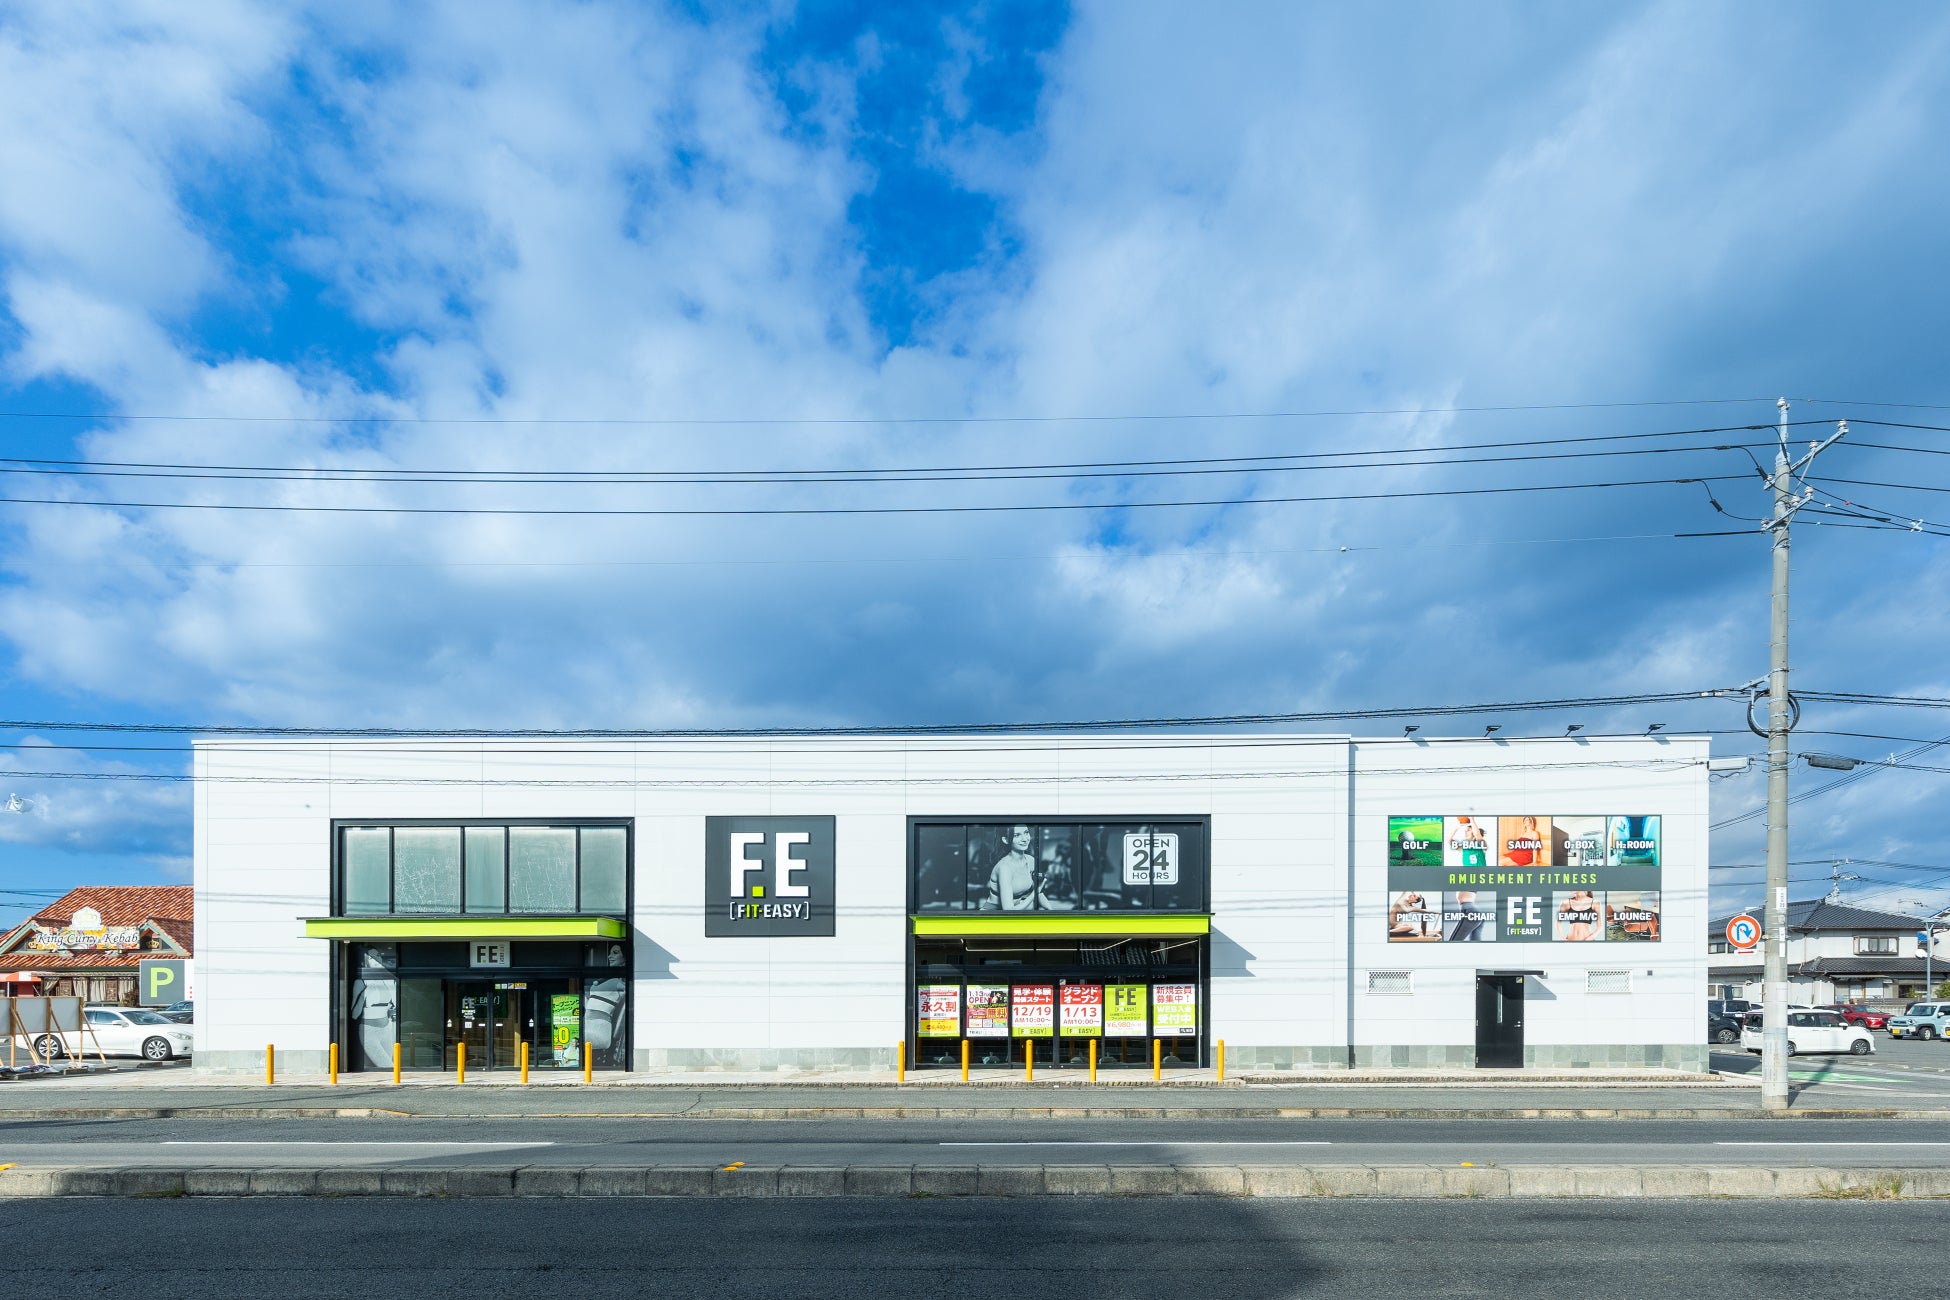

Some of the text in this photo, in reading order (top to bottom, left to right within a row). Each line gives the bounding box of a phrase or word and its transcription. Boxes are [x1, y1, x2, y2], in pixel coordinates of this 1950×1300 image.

[1132, 838, 1170, 848] OPEN
[1402, 841, 1430, 850] GOLF
[1451, 841, 1488, 850] B-BALL
[1508, 841, 1543, 850] SAUNA
[1132, 849, 1170, 871] 24
[1449, 873, 1597, 885] AMUSEMENT FITNESS
[1396, 912, 1435, 922] PILATES
[1444, 912, 1496, 921] EMP-CHAIR
[1558, 912, 1598, 921] EMP M/C
[1613, 912, 1653, 921] LOUNGE
[36, 933, 138, 945] King Curry Kebab
[150, 967, 175, 998] P
[1064, 986, 1099, 996] グランド
[1156, 985, 1193, 995] 新規会員
[1064, 995, 1099, 1004] オープン
[921, 1001, 957, 1012] 永久割
[1013, 1006, 1052, 1016] 12/19
[1064, 1007, 1098, 1017] 1/13
[1157, 1013, 1192, 1024] 受付中
